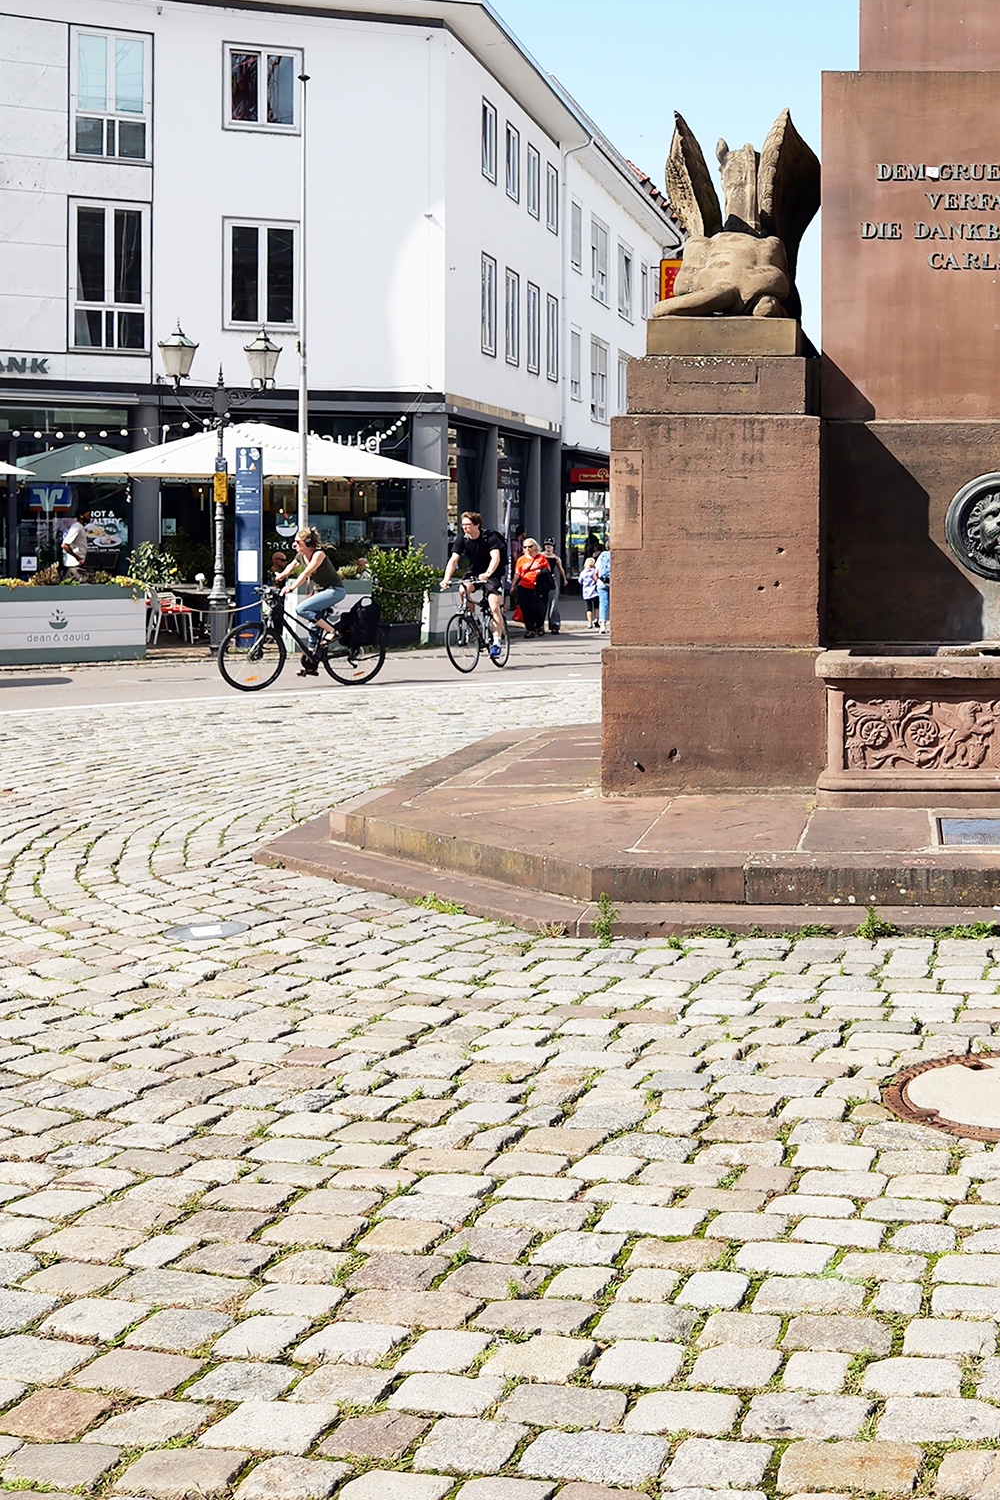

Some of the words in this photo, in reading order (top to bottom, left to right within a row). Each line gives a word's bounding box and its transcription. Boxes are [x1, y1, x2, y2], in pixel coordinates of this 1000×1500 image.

[876, 163, 926, 181] DEM
[861, 222, 902, 240] DIE
[62, 632, 90, 642] david
